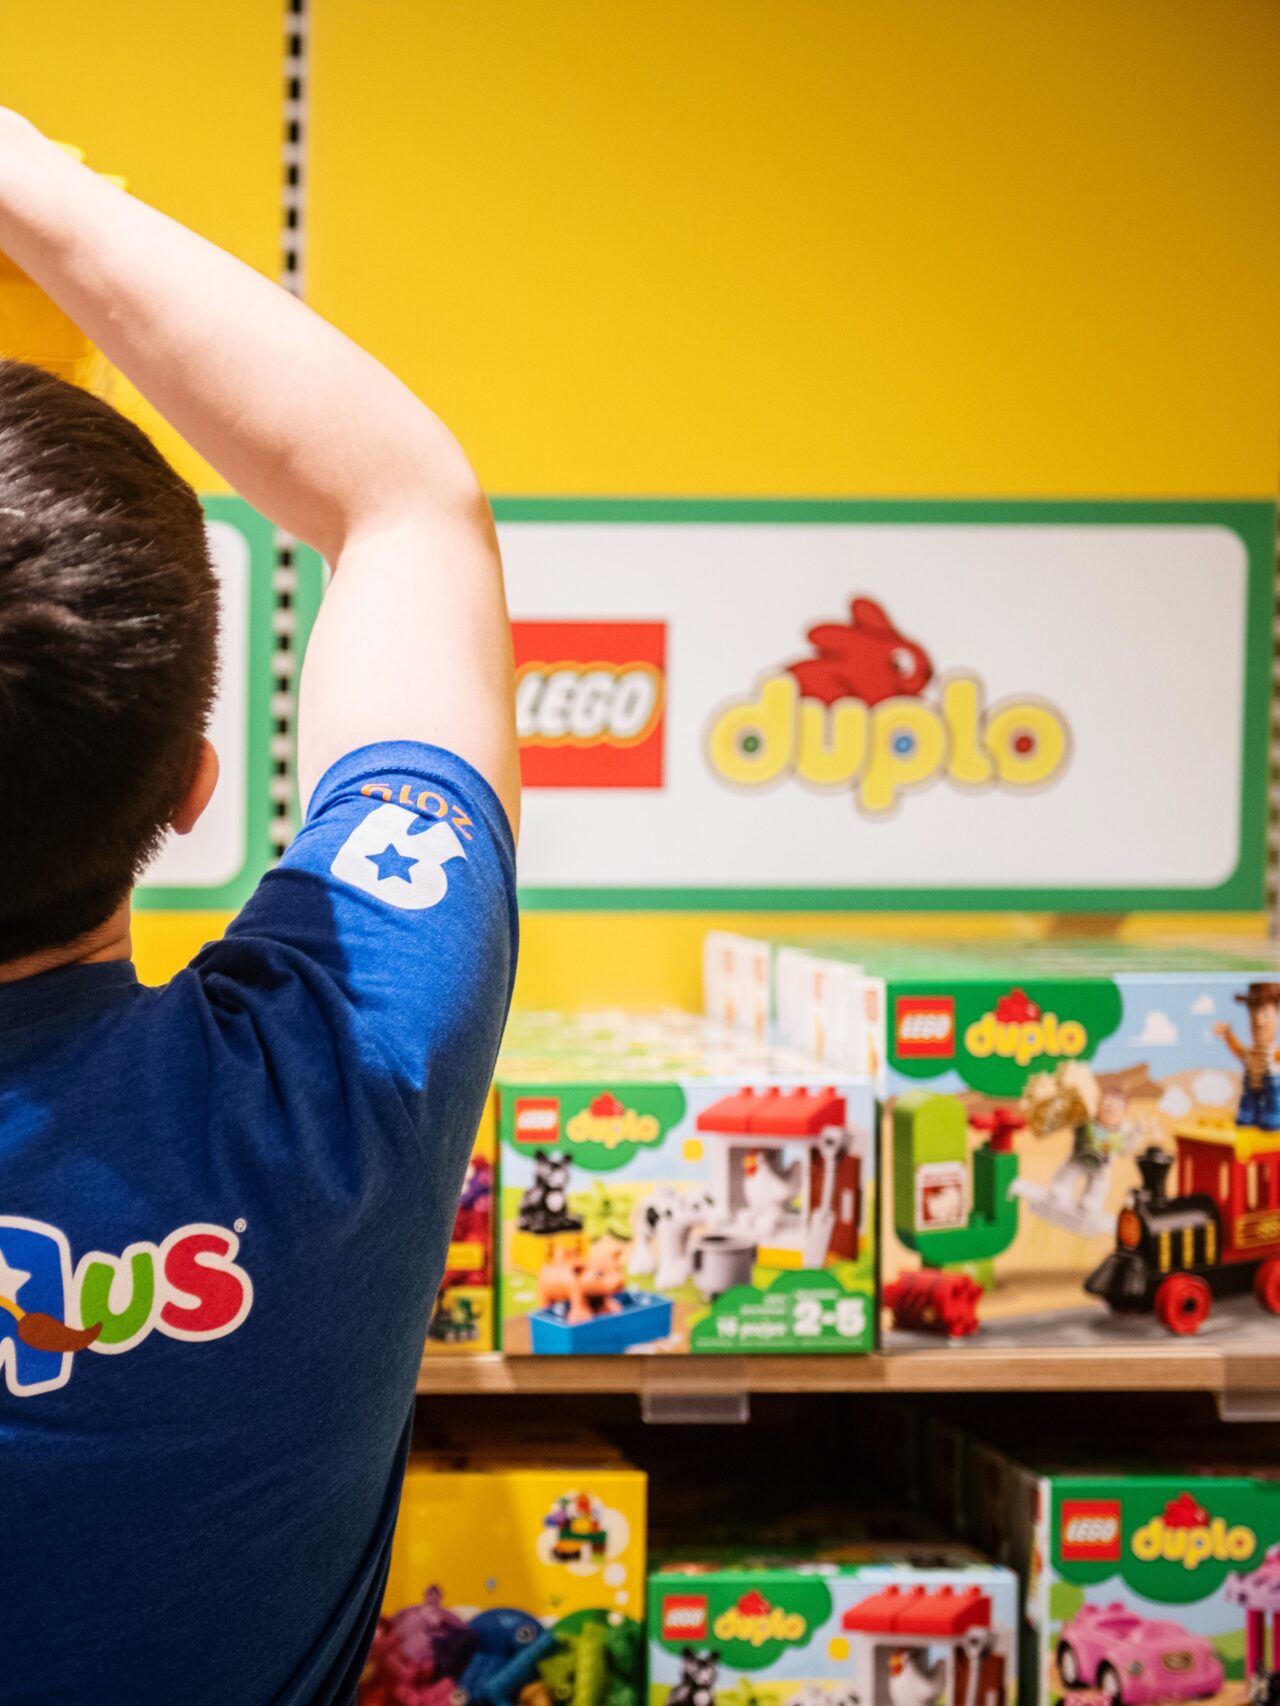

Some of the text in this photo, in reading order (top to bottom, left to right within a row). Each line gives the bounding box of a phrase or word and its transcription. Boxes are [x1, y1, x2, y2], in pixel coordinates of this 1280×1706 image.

[516, 666, 1068, 814] LEGO duplo
[965, 1012, 1087, 1066] duplo
[793, 1299, 866, 1337] 2-5
[1066, 1517, 1256, 1570] LEGO duplo
